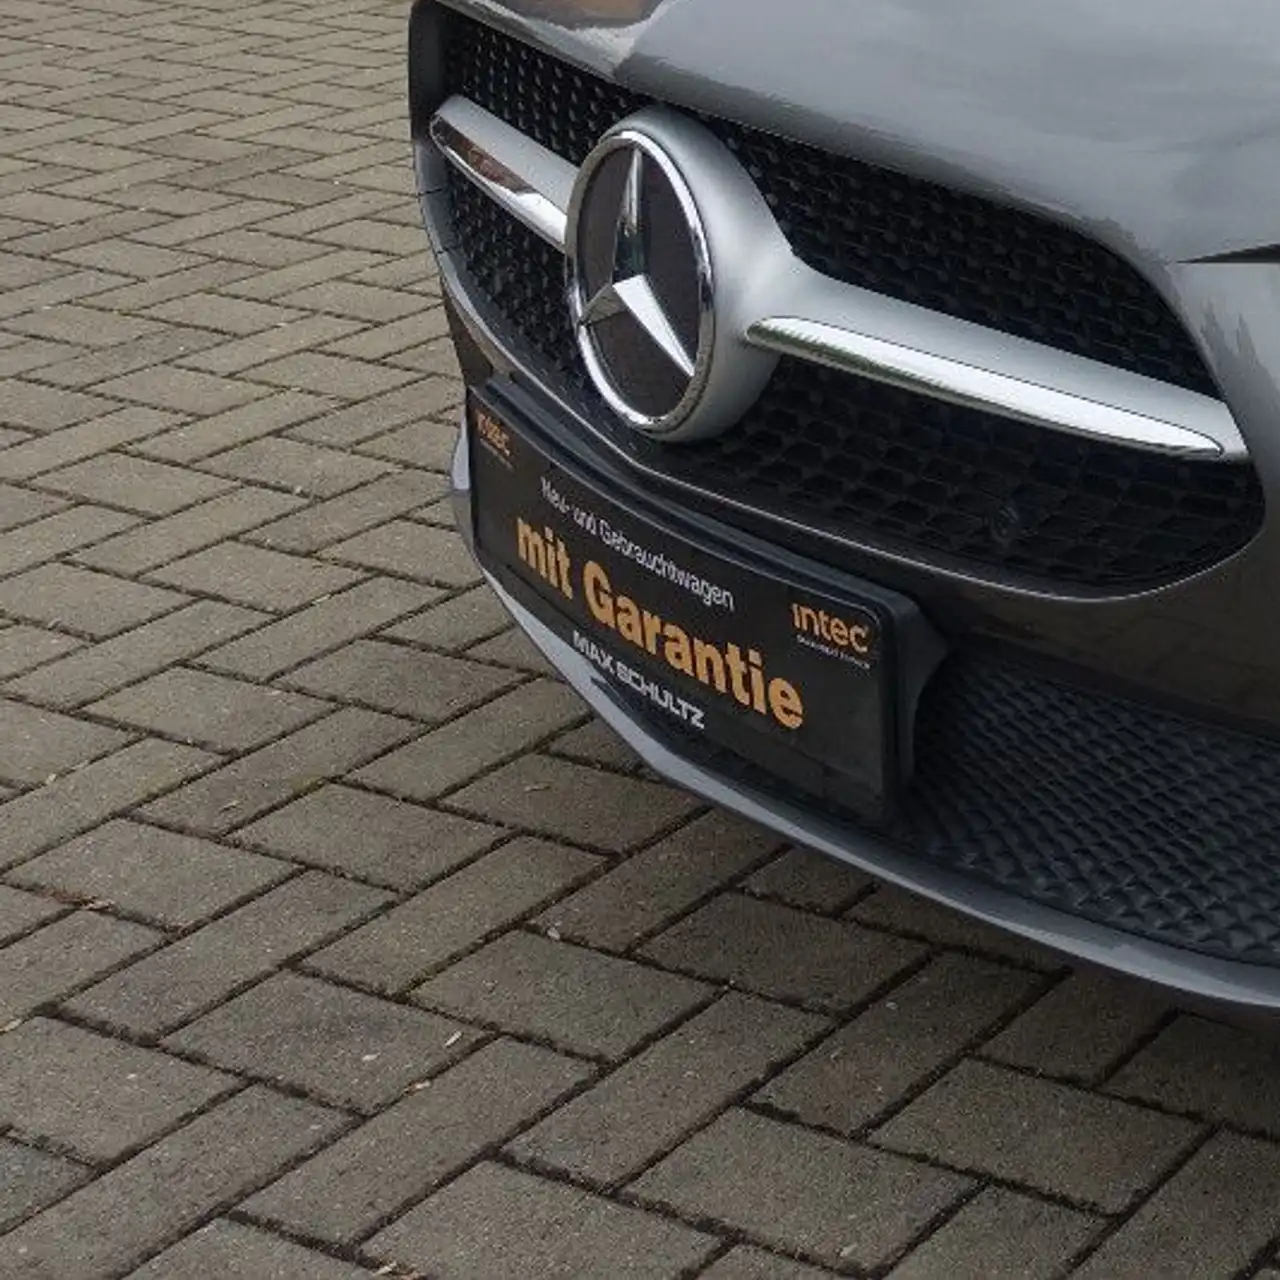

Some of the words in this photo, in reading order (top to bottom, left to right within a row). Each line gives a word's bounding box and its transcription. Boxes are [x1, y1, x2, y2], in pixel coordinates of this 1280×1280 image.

[599, 518, 736, 612] Gebrauchtwagen
[517, 517, 574, 600] mit
[583, 560, 803, 730] Garantie
[572, 629, 616, 677] MAX
[616, 661, 705, 730] SCHULTZ
